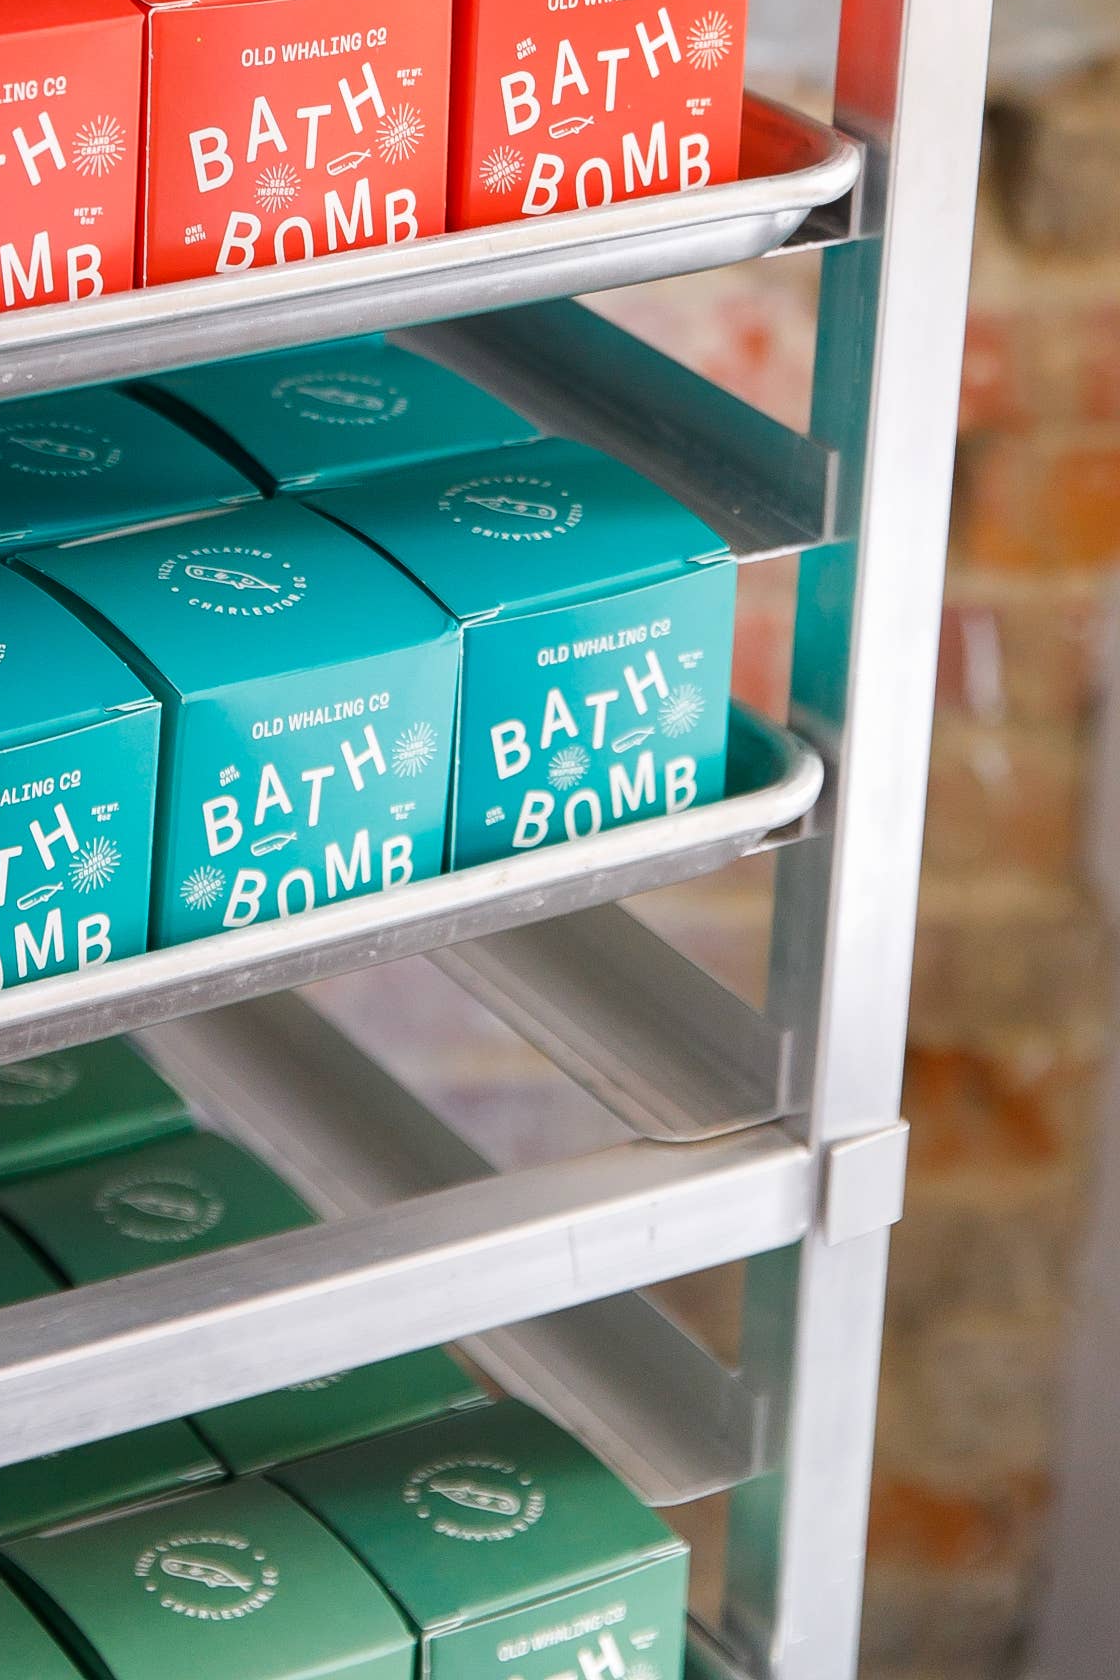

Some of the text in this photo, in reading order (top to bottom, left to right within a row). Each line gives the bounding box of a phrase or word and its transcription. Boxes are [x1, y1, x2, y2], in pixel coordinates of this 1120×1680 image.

[241, 46, 276, 68] OLD
[281, 32, 362, 63] WHALING
[500, 7, 682, 136] BATH
[189, 62, 386, 193] BATH
[521, 120, 711, 215] BOMB
[215, 177, 419, 273] BOMB
[158, 560, 177, 580] FIZZY
[191, 547, 272, 559] RELAXING
[293, 576, 307, 588] SC
[537, 644, 570, 667] OLD
[573, 625, 647, 659] WHALING
[252, 716, 284, 740] OLD
[288, 699, 365, 731] WHALING
[490, 650, 670, 780] BATH
[202, 724, 387, 857] BATH
[512, 750, 698, 848] BOMB
[222, 829, 414, 928] BOMB
